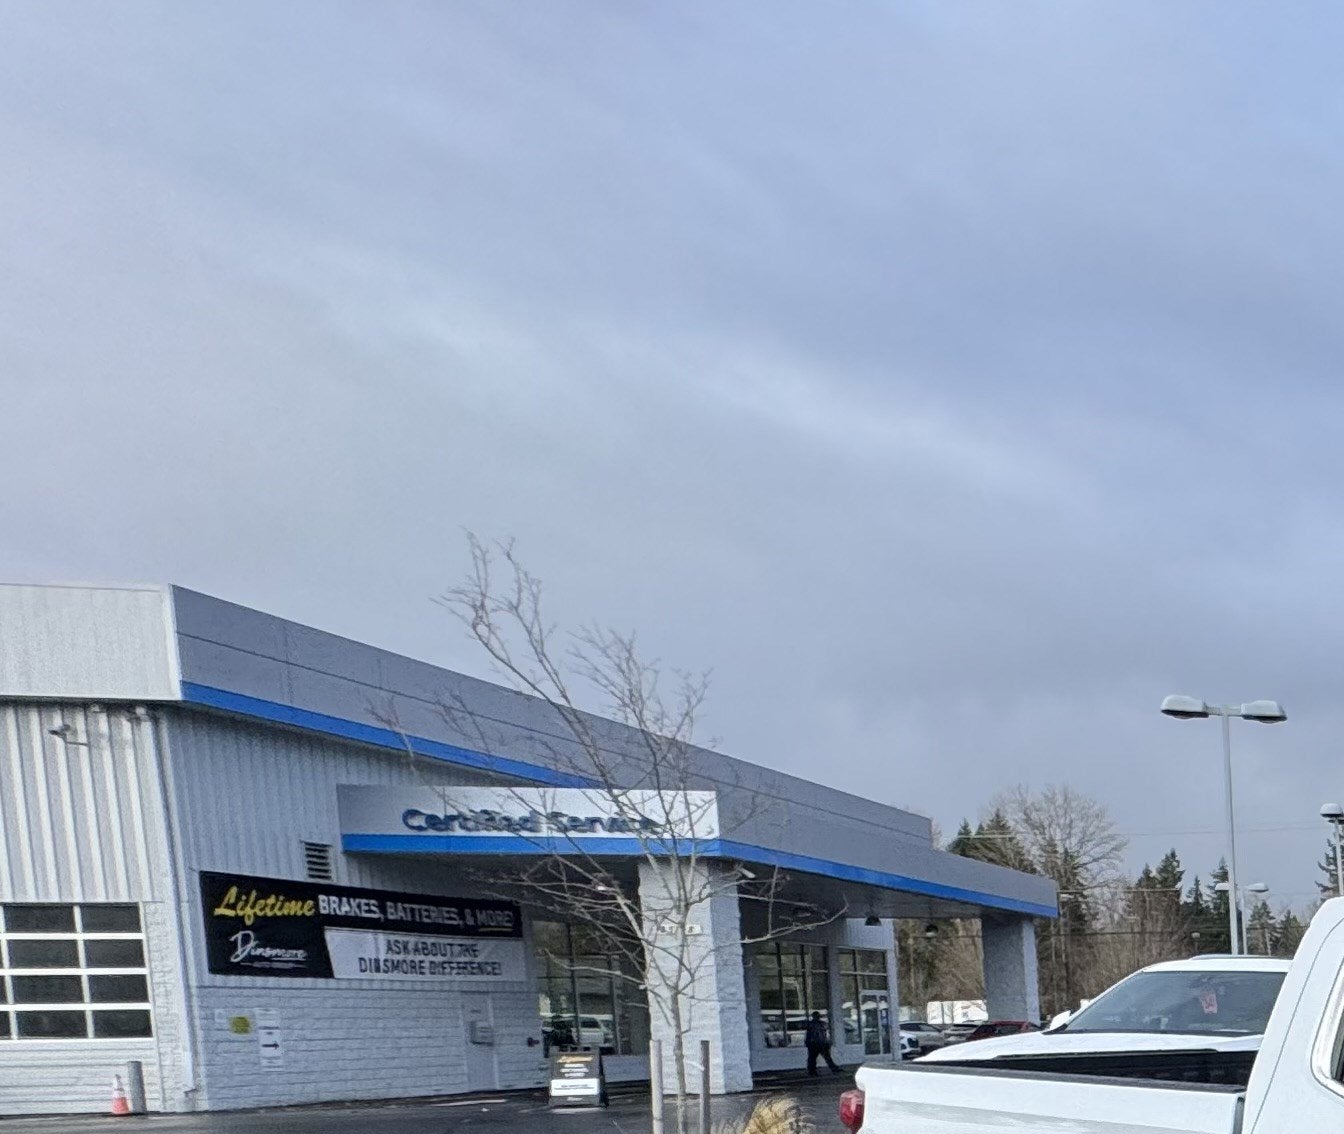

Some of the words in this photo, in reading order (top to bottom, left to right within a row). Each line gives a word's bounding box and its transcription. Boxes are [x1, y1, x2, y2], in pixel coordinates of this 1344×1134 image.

[213, 885, 316, 926] Lifetime
[317, 894, 384, 923] BRAKES,
[385, 939, 410, 955] ASK
[412, 941, 454, 957] ABOUT
[358, 957, 426, 975] DINSMORE
